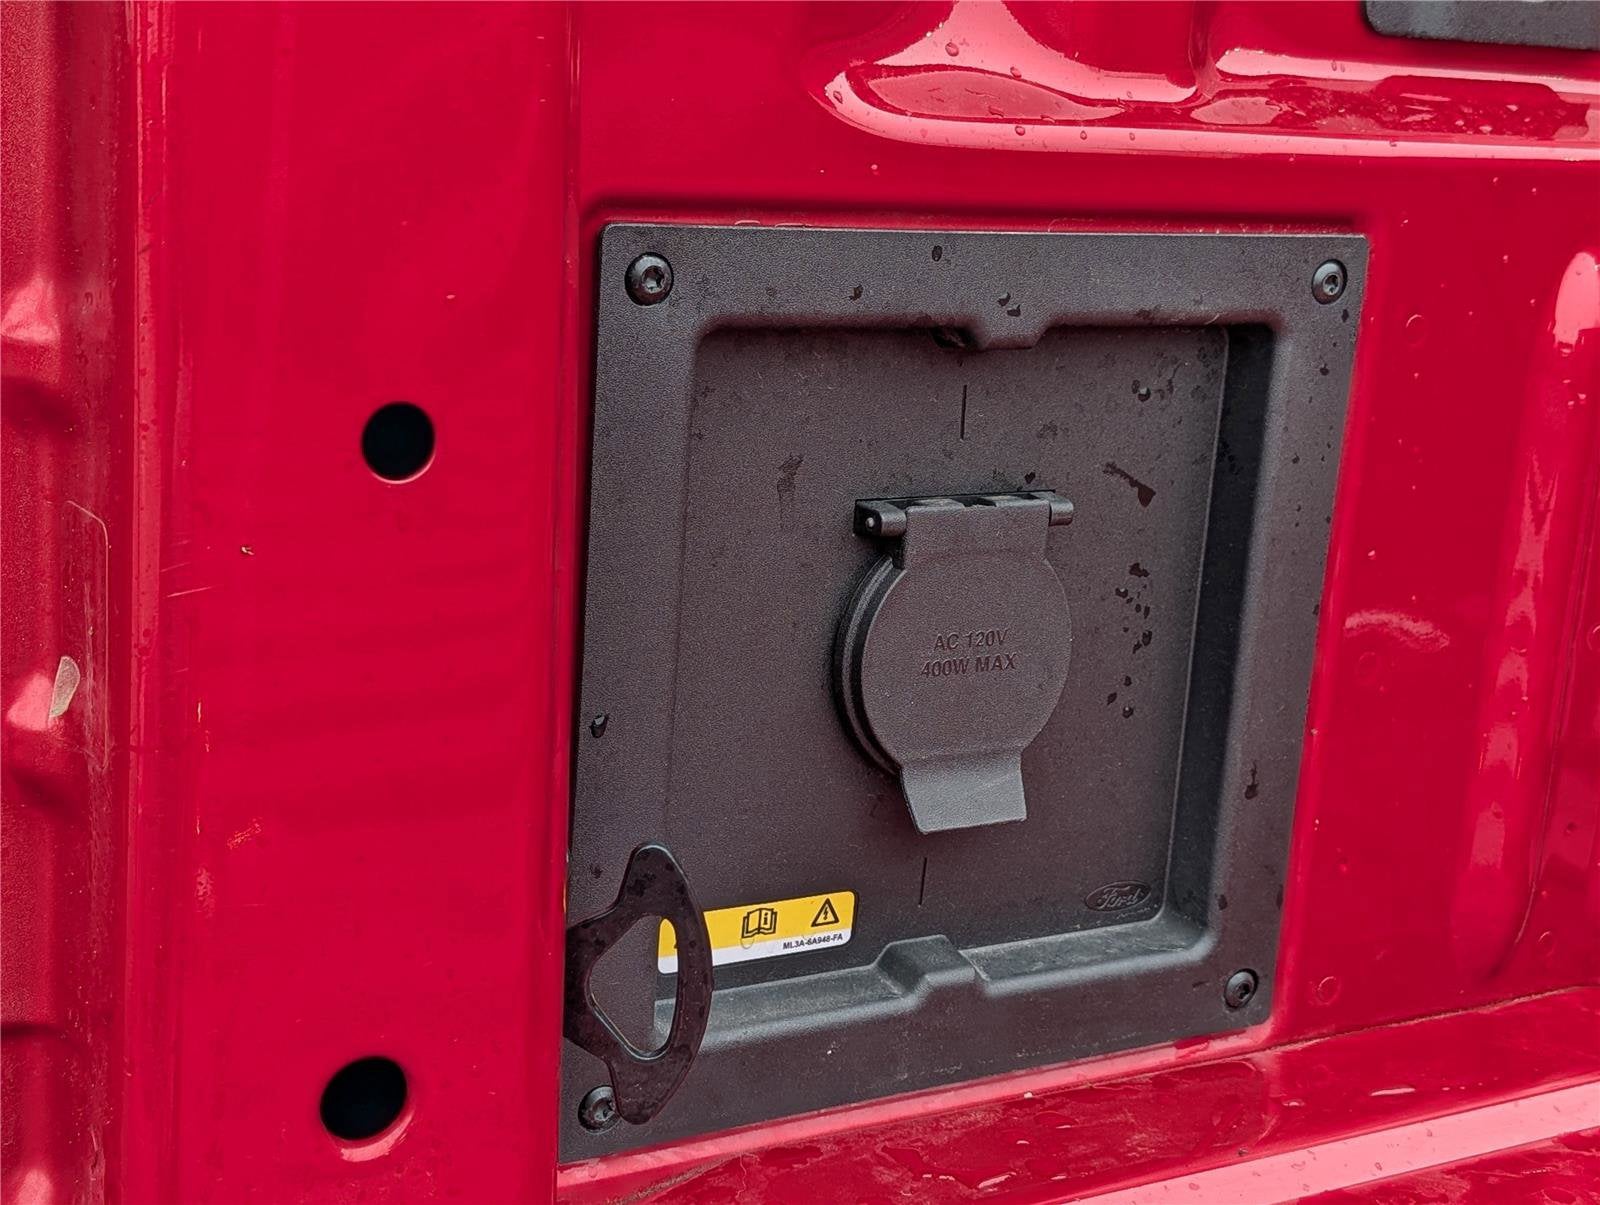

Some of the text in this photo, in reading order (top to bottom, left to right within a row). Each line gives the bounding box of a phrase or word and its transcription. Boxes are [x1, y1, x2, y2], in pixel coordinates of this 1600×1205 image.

[934, 627, 1008, 651] AC 120V
[921, 652, 1017, 678] 400W MAX
[1091, 886, 1143, 909] Ford
